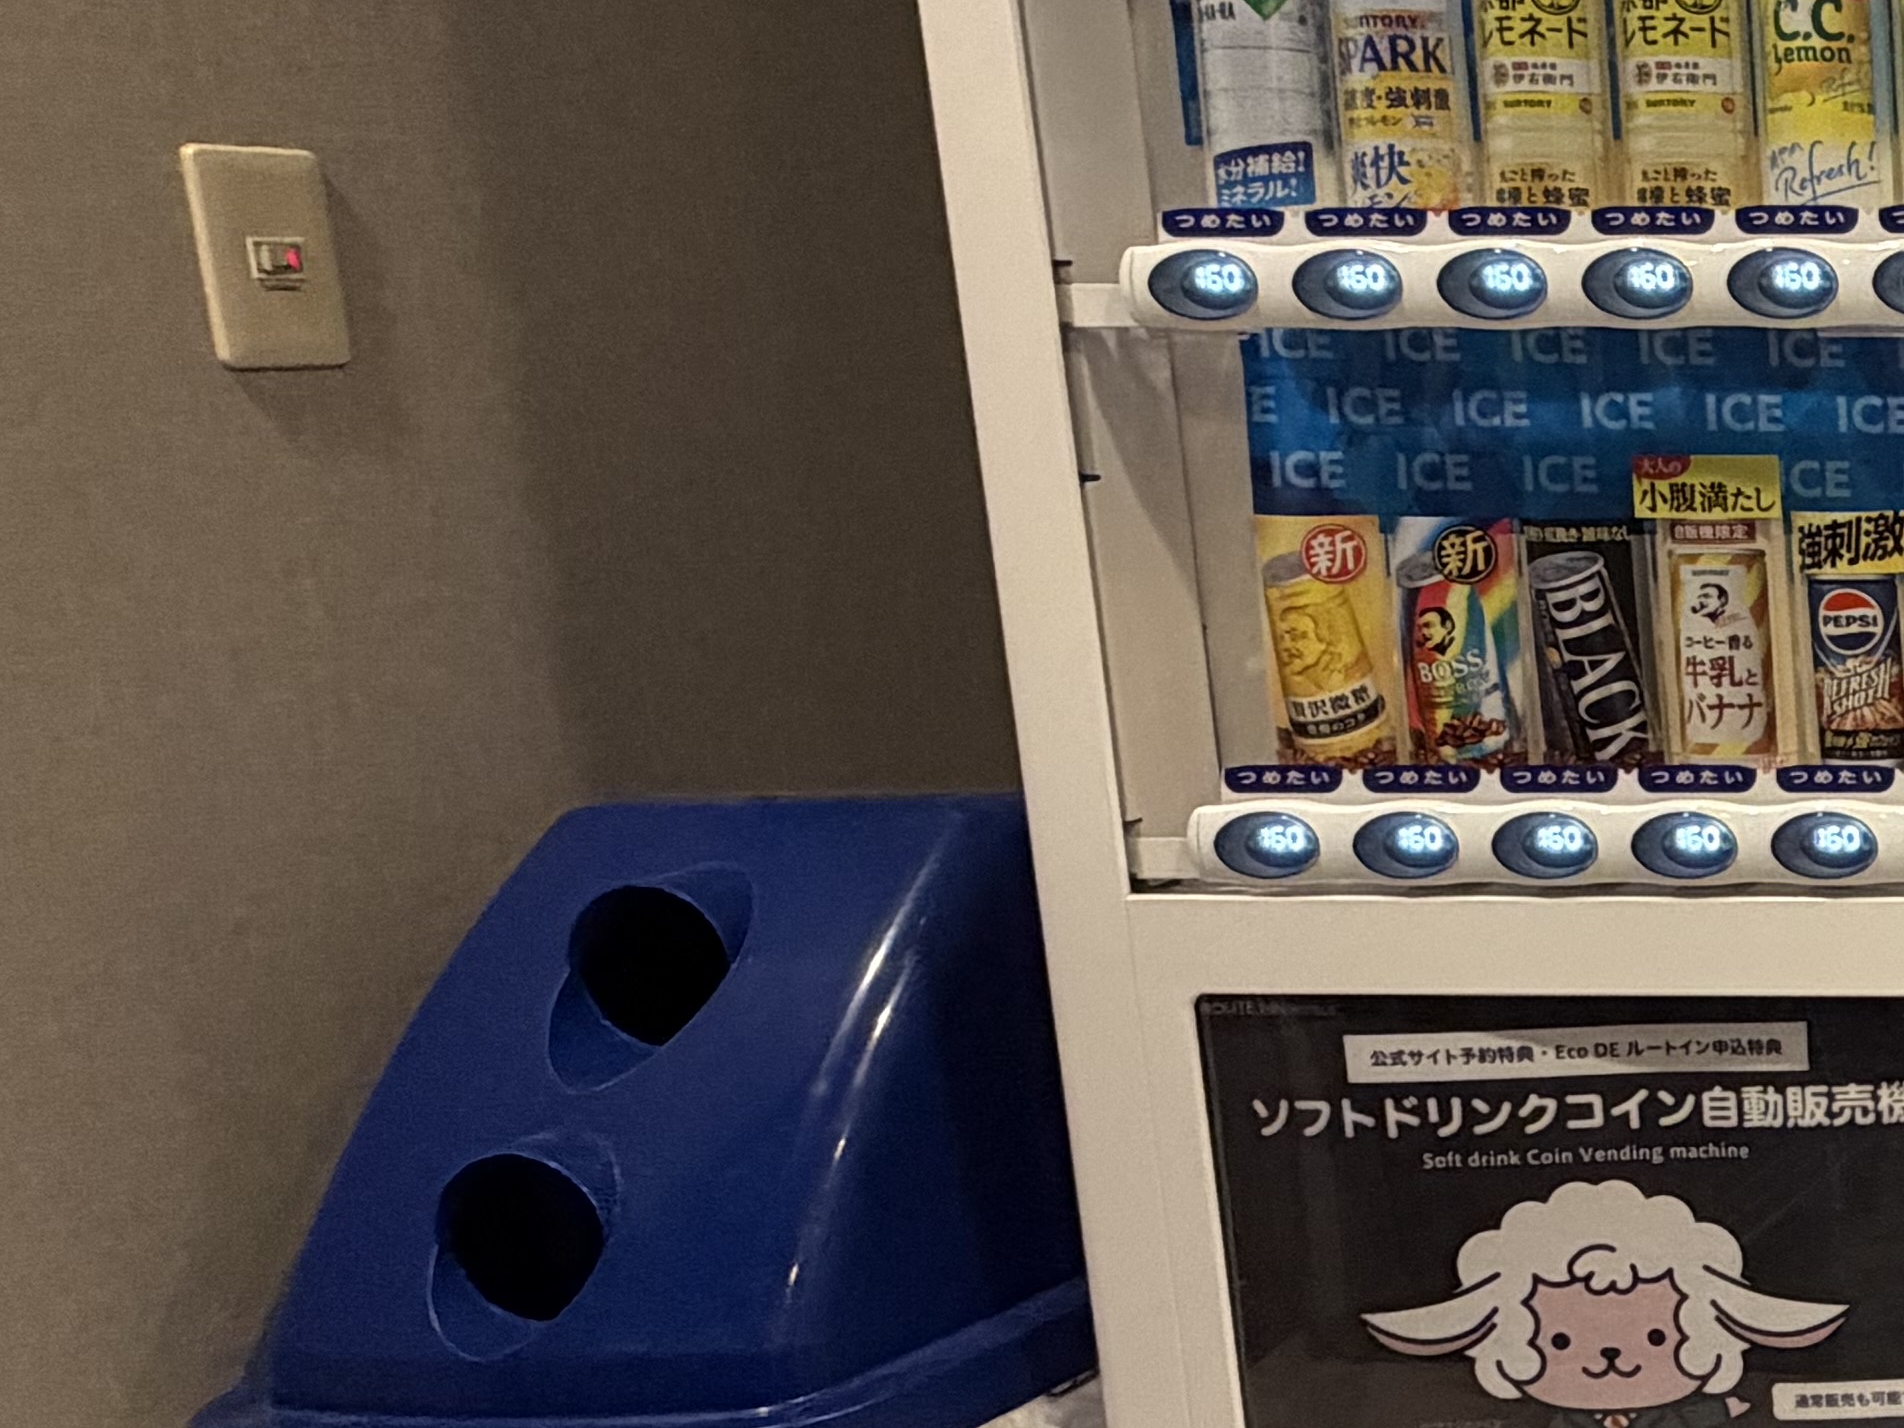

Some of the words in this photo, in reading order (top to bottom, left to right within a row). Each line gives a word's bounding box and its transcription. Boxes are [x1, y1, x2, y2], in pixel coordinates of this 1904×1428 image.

[1462, 212, 1557, 227] つめたい
[1454, 390, 1531, 429] ICE
[1639, 481, 1776, 514] 小腹満たし
[1308, 529, 1357, 577] 新
[1417, 648, 1488, 685] BOSS
[1545, 572, 1649, 762] BLACK
[1684, 654, 1759, 689] 牛乳と
[1686, 692, 1764, 731] バナナ
[1238, 770, 1329, 785] つめたい
[1556, 1041, 1588, 1060] Eco
[1594, 1040, 1621, 1059] DE
[1626, 1035, 1783, 1059] ルートイン申込特典
[1422, 1150, 1462, 1170] Soft
[1467, 1148, 1521, 1170] drink
[1526, 1146, 1573, 1167] Coin
[1578, 1143, 1664, 1167] Vending
[1669, 1140, 1750, 1163] machine
